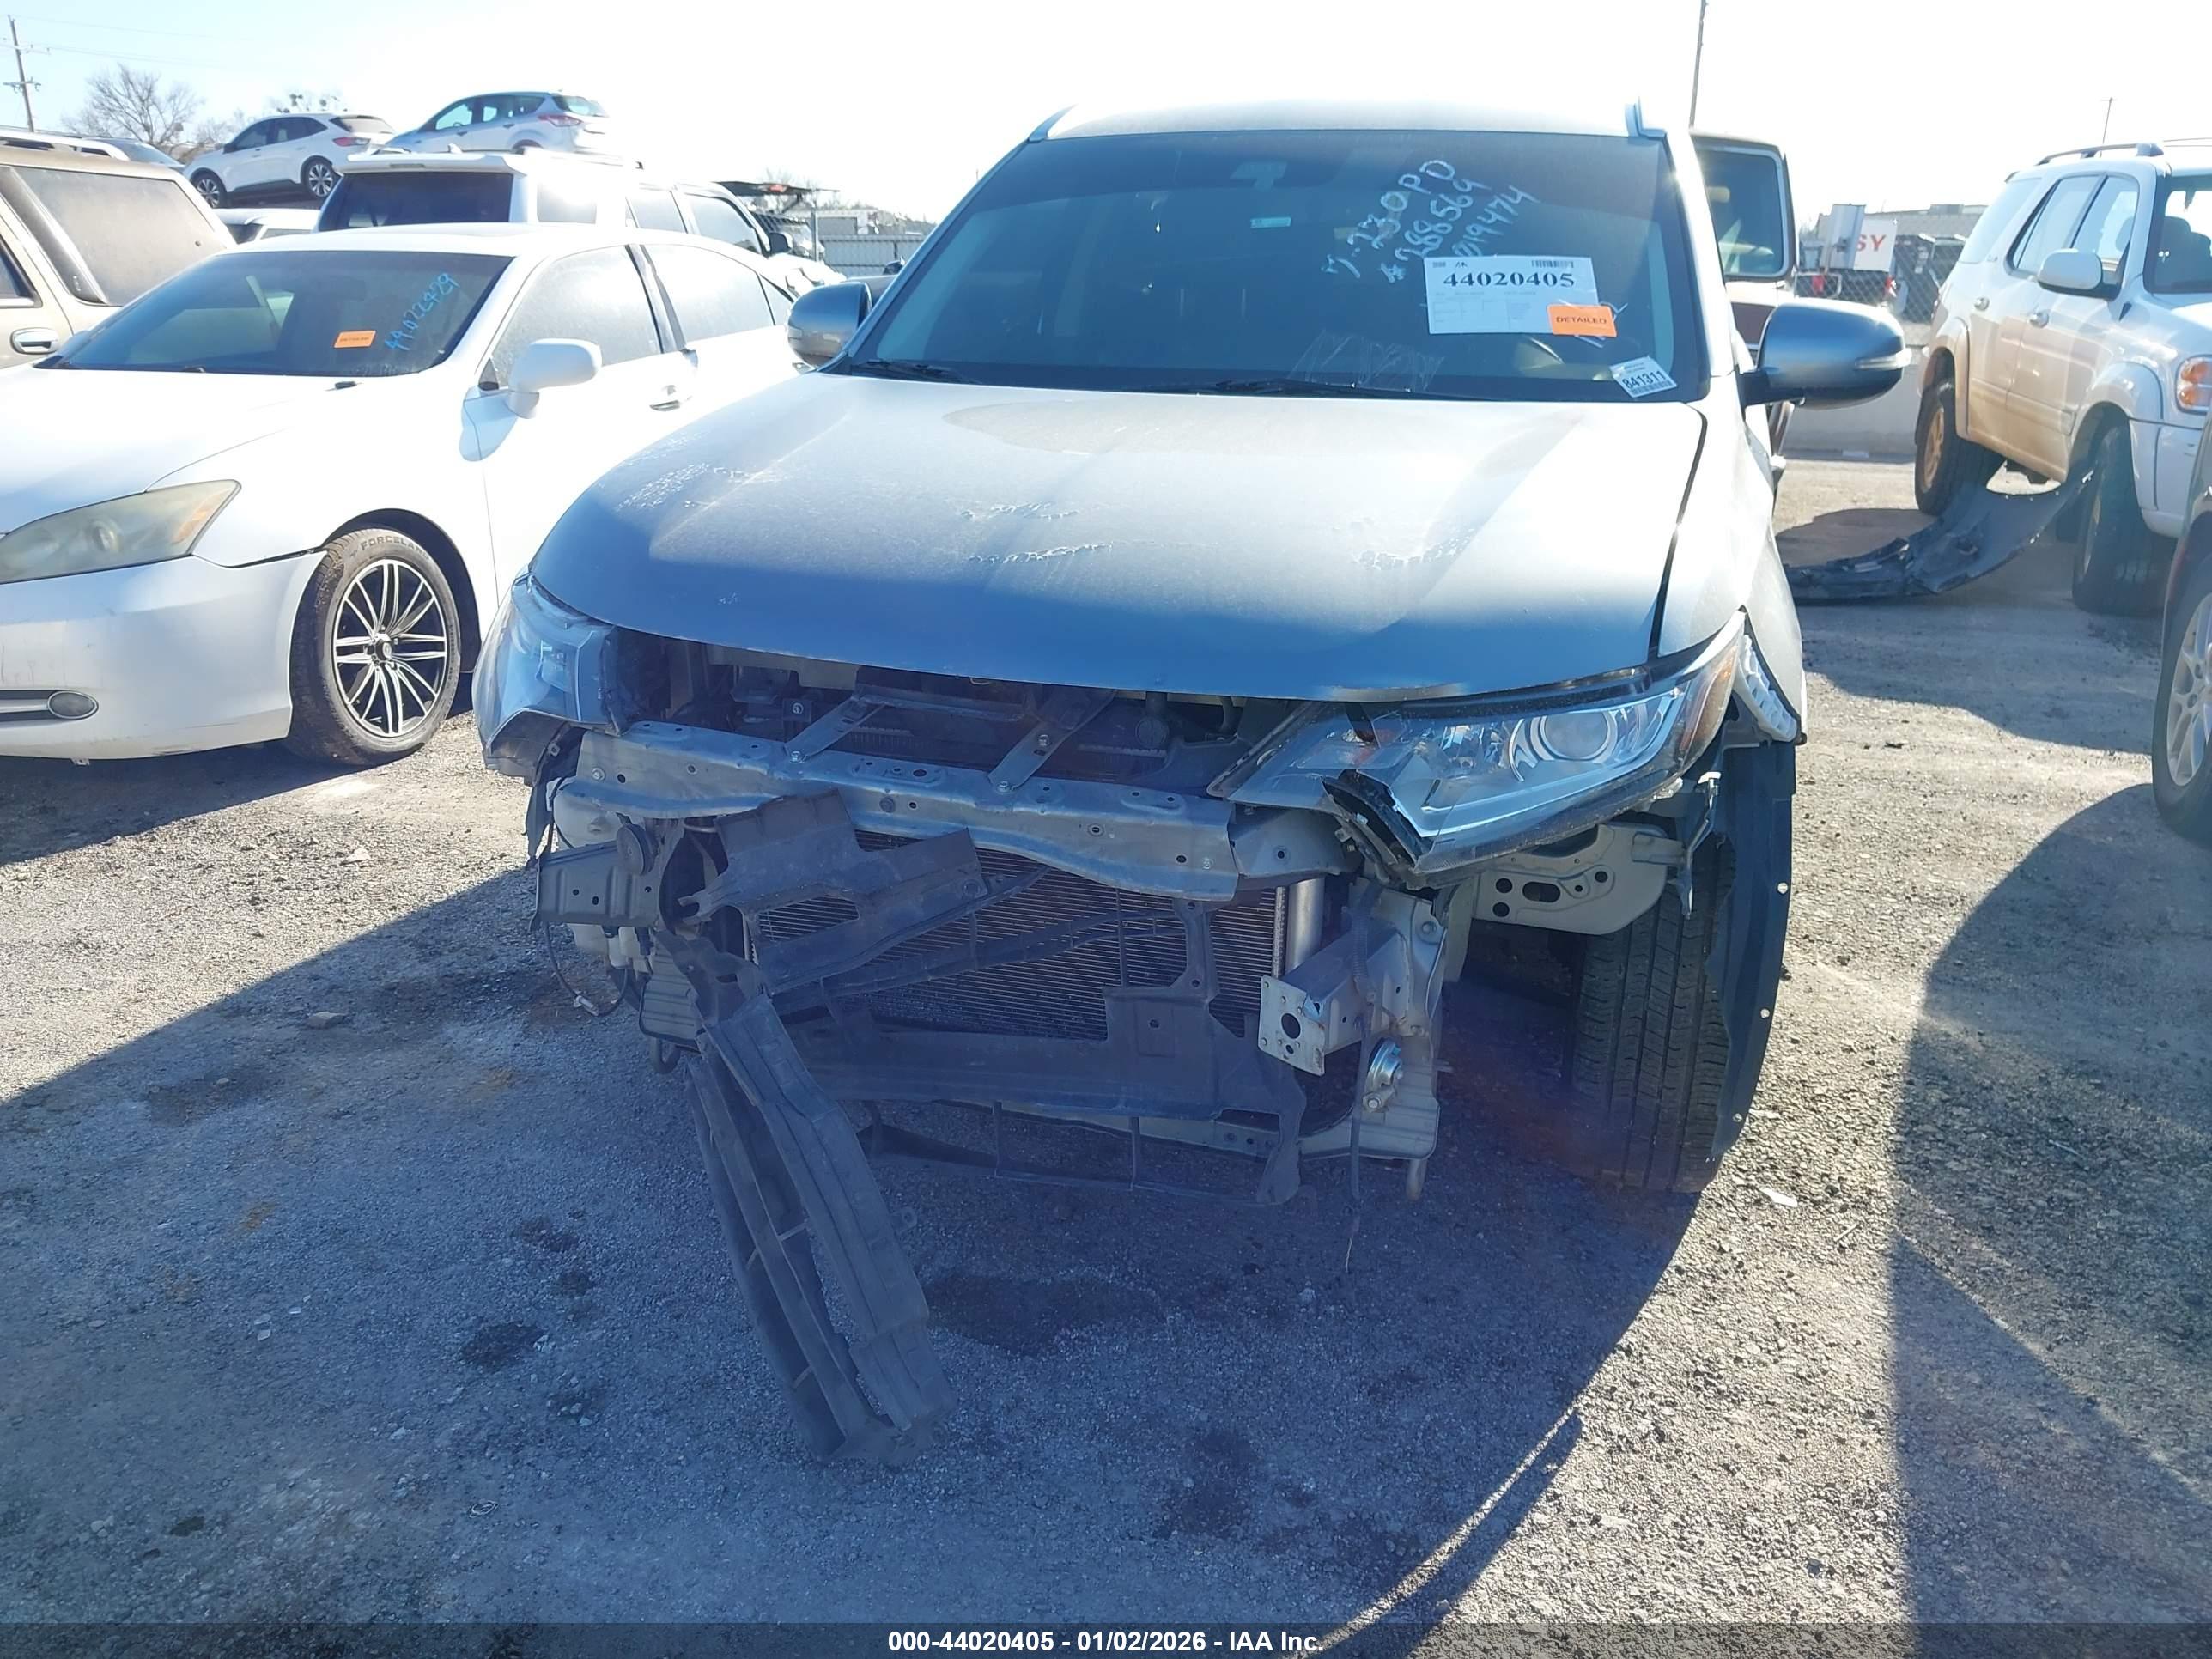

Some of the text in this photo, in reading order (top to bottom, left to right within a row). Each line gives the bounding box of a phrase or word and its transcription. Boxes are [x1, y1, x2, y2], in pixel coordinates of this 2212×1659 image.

[1443, 271, 1575, 289] 44020405
[1555, 315, 1607, 325] DETAILED
[1622, 370, 1668, 389] 841311
